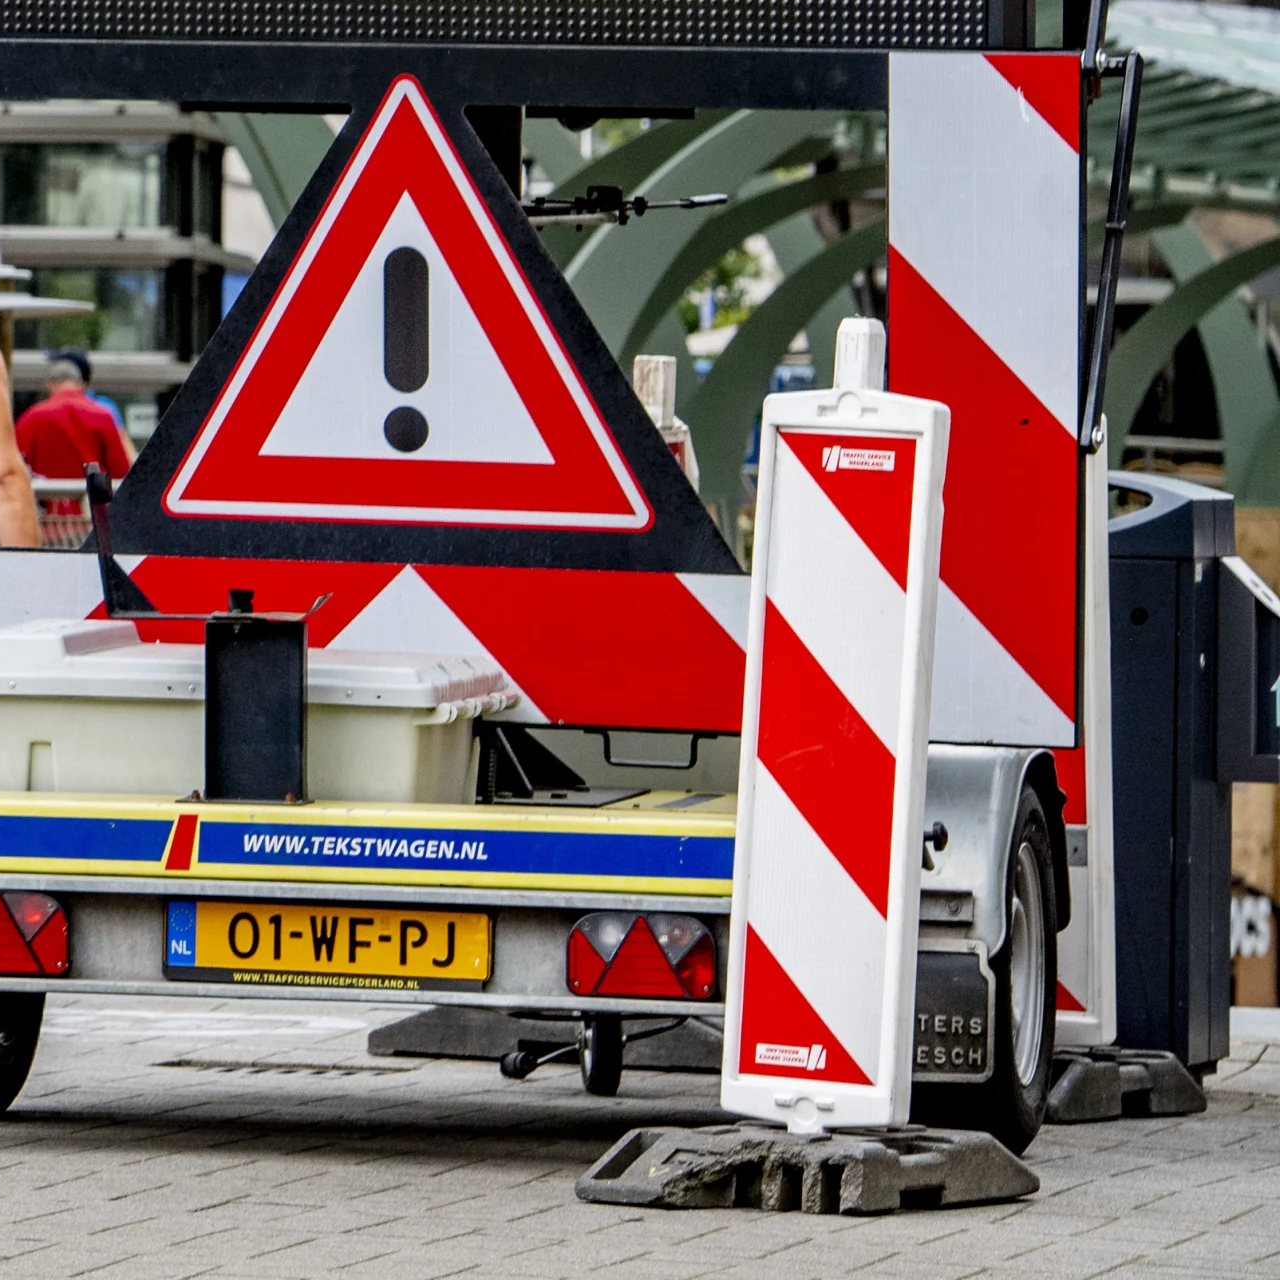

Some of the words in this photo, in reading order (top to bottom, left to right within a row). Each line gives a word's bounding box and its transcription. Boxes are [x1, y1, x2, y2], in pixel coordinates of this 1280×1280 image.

[842, 452, 866, 460] TRAFFIC
[867, 453, 892, 461] SERVICE
[243, 834, 488, 861] WWW.TEKSTWAGEN.NL
[171, 938, 192, 956] NL
[228, 912, 456, 967] 01-WF-PJ
